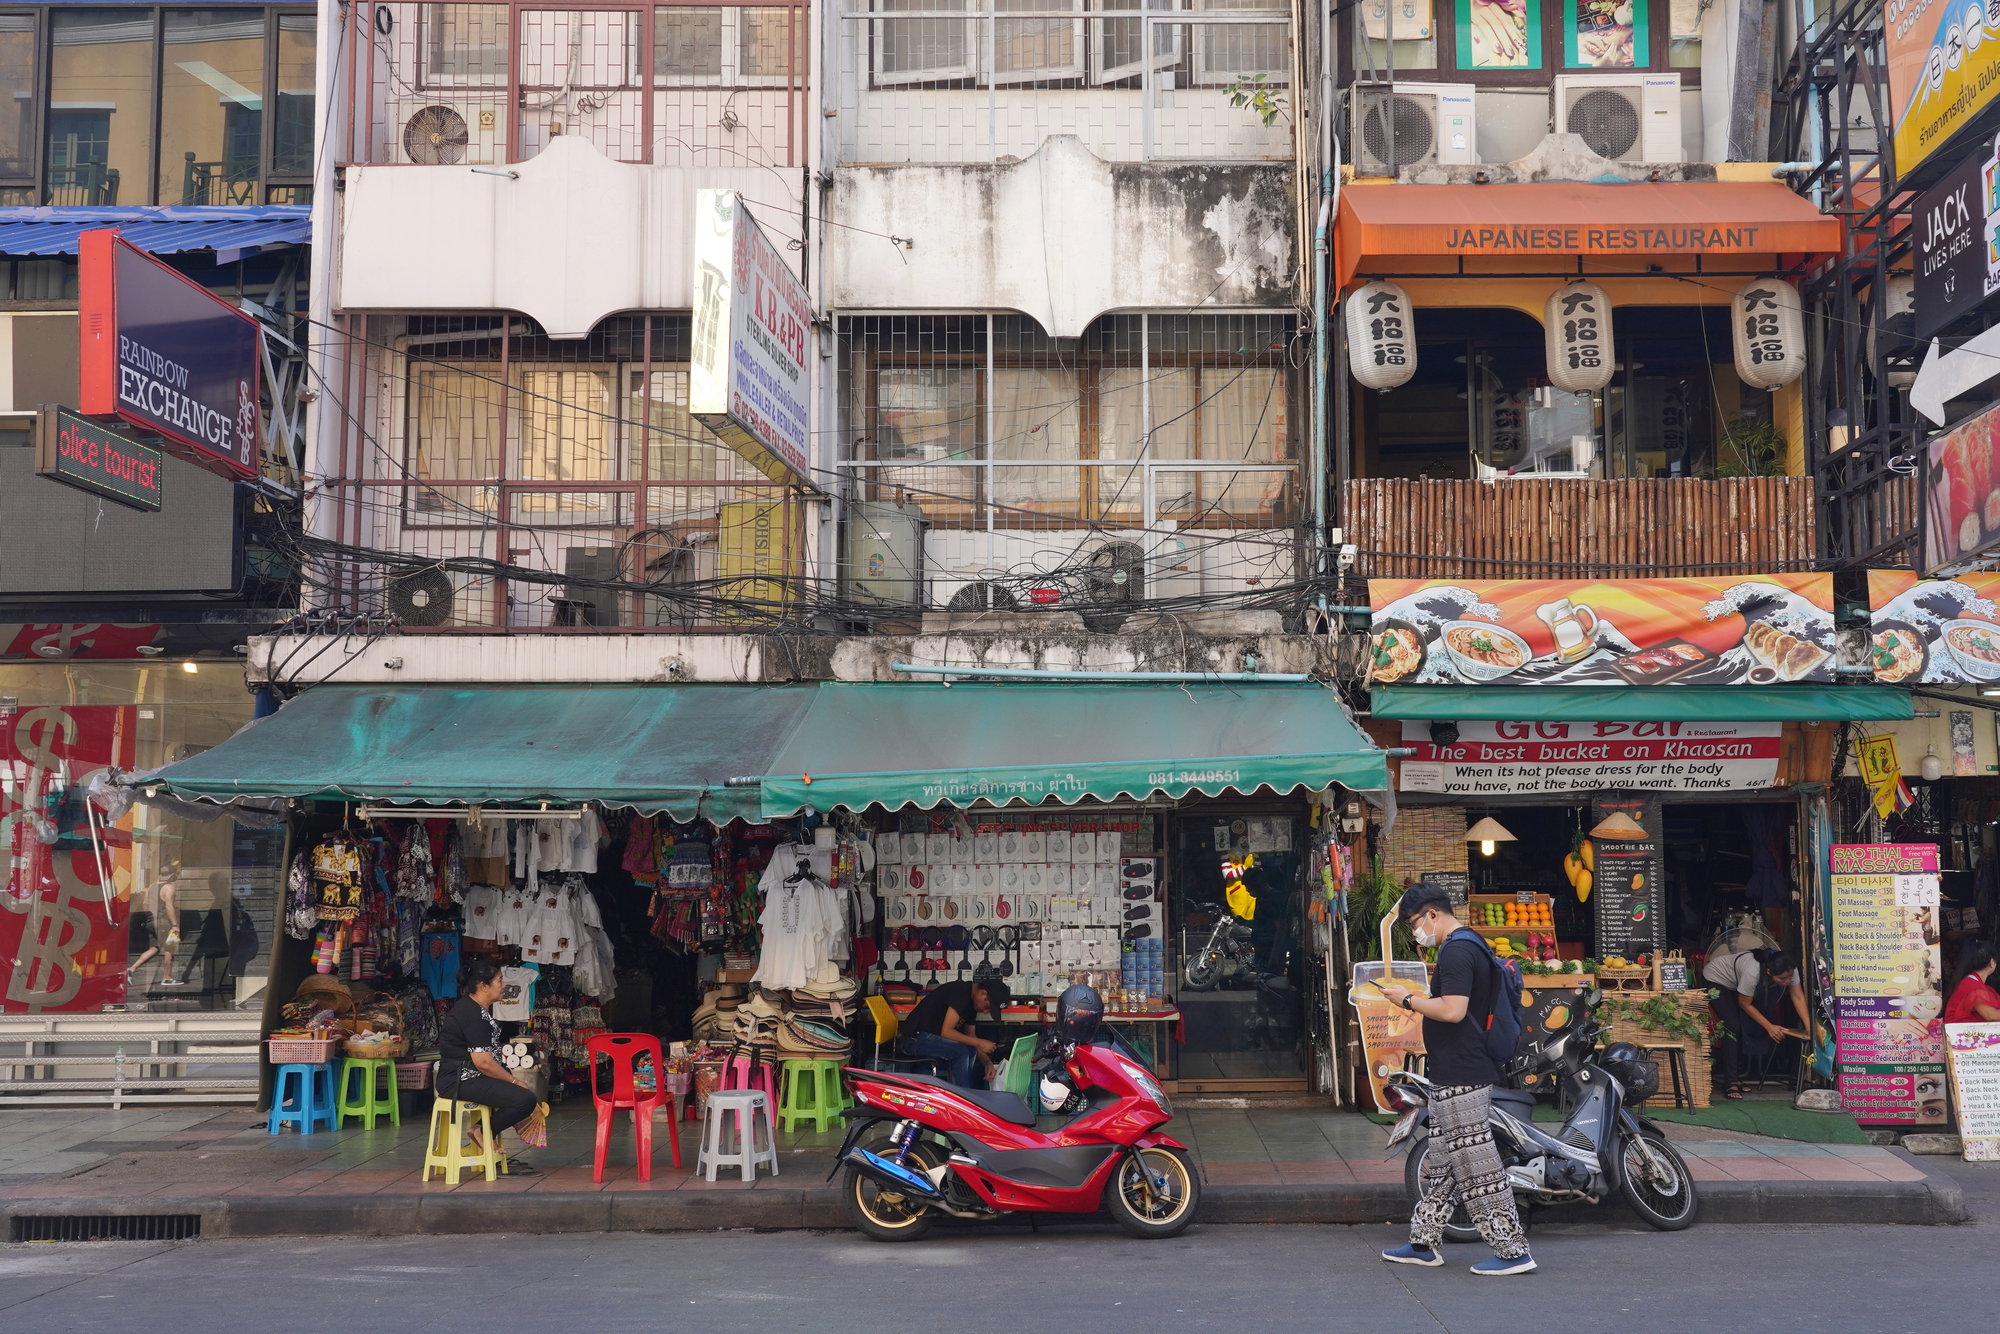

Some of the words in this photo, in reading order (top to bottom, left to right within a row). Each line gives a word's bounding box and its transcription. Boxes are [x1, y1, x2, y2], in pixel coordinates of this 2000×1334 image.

[1920, 84, 1977, 146] ร้านอาหารญี่ปุ่น
[1923, 182, 1970, 253] JACK
[1445, 228, 1579, 249] JAPANESE
[1588, 227, 1759, 249] RESTAURANT
[1924, 246, 1948, 277] LIVES
[1950, 227, 1972, 259] HERE
[746, 314, 771, 356] STERLING
[771, 342, 787, 371] SILVER
[787, 358, 799, 385] SHOP
[120, 335, 189, 391] RAINBOW
[119, 364, 232, 451] EXCHANGE
[105, 441, 157, 490] tourist
[754, 507, 770, 549] SHOP
[1495, 720, 1570, 740] GG
[1428, 743, 1467, 760] The
[1480, 743, 1526, 760] best
[1539, 742, 1610, 760] bucket
[1623, 745, 1650, 759] on
[1664, 741, 1752, 758] Khaosan
[1456, 766, 1492, 777] When
[1498, 766, 1514, 777] its
[1519, 766, 1542, 777] hot
[1546, 766, 1591, 778] please
[1595, 764, 1632, 776] dress
[1635, 764, 1658, 776] for
[1661, 764, 1684, 775] the
[1688, 763, 1724, 777] body
[1149, 769, 1240, 785] 081-8449551
[1050, 773, 1087, 792] ผ้าใบ
[1444, 782, 1470, 793] you
[1474, 781, 1511, 793] have,
[1516, 780, 1540, 791] not
[1544, 780, 1567, 790] the
[1571, 778, 1606, 790] body
[1610, 779, 1634, 789] you
[1640, 778, 1677, 788] want.
[1684, 778, 1731, 788] Thanks
[977, 824, 1045, 834] STEING
[1101, 822, 1141, 833] SHOP
[1834, 848, 1866, 860] SAO
[1868, 847, 1901, 859] THAI
[1834, 858, 1924, 873] MASSAGE
[1836, 876, 1858, 886] 타이
[1860, 876, 1893, 886] 마사지
[1852, 888, 1877, 896] Massage
[1838, 898, 1847, 906] Oil
[1848, 898, 1874, 907] Massage
[1854, 910, 1879, 918] Massage
[1839, 932, 1854, 940] Nack
[1855, 932, 1869, 940] Back
[1876, 932, 1903, 940] Shoulder
[1876, 943, 1903, 951] Shoulder
[1865, 954, 1877, 962] Tiger
[1840, 974, 1856, 982] Aloe
[1841, 986, 1861, 994] Herbal
[1840, 998, 1857, 1007] Body
[1857, 998, 1875, 1006] Scrub
[1366, 1014, 1402, 1023] SMOOTHIE
[1840, 1009, 1859, 1017] Facial
[1860, 1010, 1886, 1018] Massage
[1842, 1020, 1870, 1028] Manicure
[1842, 1032, 1868, 1040] Pedicure
[1367, 1040, 1402, 1050] SMOOTHIE
[1874, 1043, 1899, 1051] Pedicure
[1843, 1054, 1872, 1062] Manicure
[1876, 1054, 1901, 1062] Pedicure
[1902, 1054, 1913, 1062] Gel
[1842, 1066, 1867, 1074] Waxing
[1843, 1076, 1867, 1085] Eyelash
[1868, 1076, 1890, 1086] Tinting
[1964, 1078, 1980, 1086] Back
[1868, 1088, 1891, 1097] Tinting
[1844, 1100, 1867, 1108] Eyelash
[1970, 1112, 1996, 1120] Oriental
